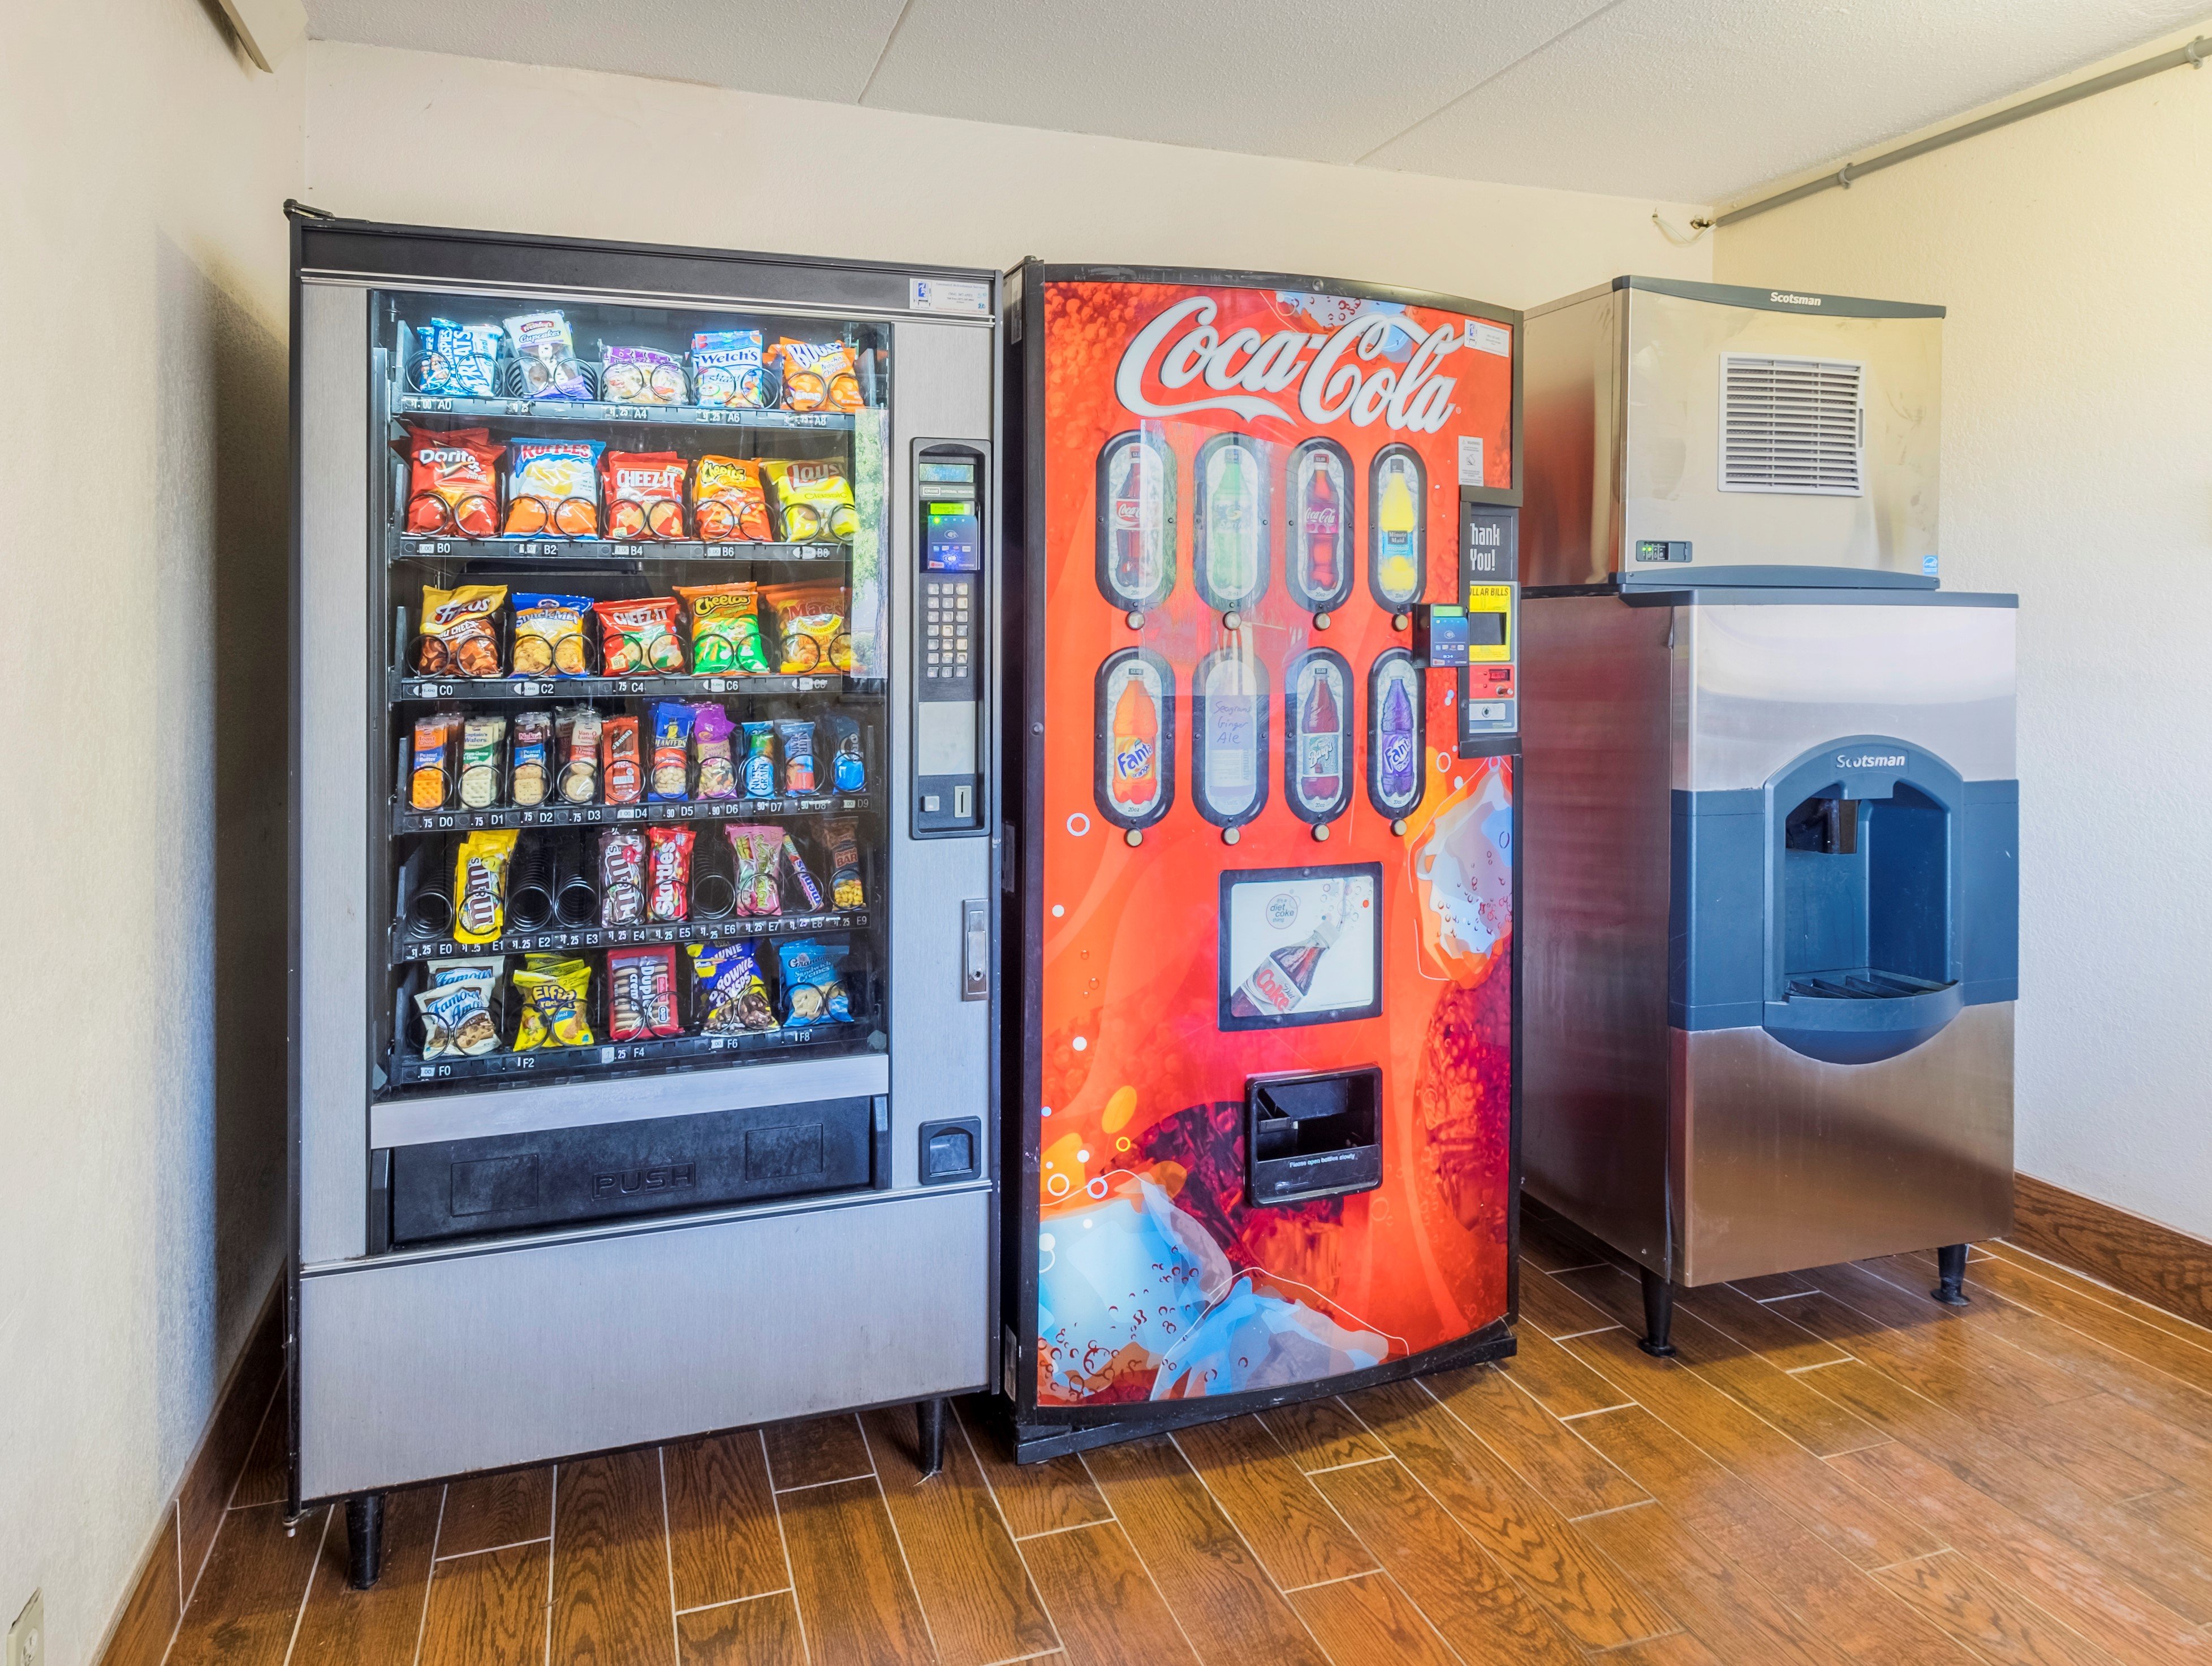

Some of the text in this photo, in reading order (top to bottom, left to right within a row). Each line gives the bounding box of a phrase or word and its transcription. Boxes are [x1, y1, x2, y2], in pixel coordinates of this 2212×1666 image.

[1770, 292, 1821, 306] Scotsman
[519, 330, 561, 343] Cupcakes
[701, 350, 758, 364] Welch's
[1115, 296, 1465, 434] Coca-Cola
[438, 400, 452, 410] A0
[635, 408, 647, 419] A4
[728, 412, 740, 423] A6
[814, 416, 826, 426] A8
[419, 449, 482, 473] Doritos
[701, 462, 745, 484] Cheetos
[437, 543, 451, 554] B0
[544, 545, 557, 555] B2
[631, 546, 643, 556] B4
[722, 547, 735, 557] B6
[1470, 549, 1496, 571] You!
[1490, 587, 1509, 597] BILLS
[695, 594, 751, 617] Cheetos
[435, 599, 490, 624] Fros
[439, 685, 453, 696] C0
[541, 684, 554, 694] C2
[631, 681, 644, 692] C4
[727, 680, 739, 691] C6
[1218, 716, 1249, 731] Ginger
[1217, 732, 1241, 744] Ale
[1116, 742, 1154, 778] Fanta
[1836, 754, 1905, 769] Scotsman
[753, 801, 783, 813] .90 D7
[797, 800, 809, 811] .90
[857, 799, 869, 808] D9
[635, 808, 648, 818] D4
[663, 806, 694, 819] .90 D5
[708, 804, 739, 815] .90 D6
[471, 814, 503, 827] .75 D1
[520, 812, 553, 824] .75 D2
[570, 810, 601, 823] .75 D3
[419, 817, 453, 828] .75 D0
[836, 853, 857, 867] BAR
[656, 841, 676, 916] Skittles
[1270, 903, 1286, 912] diet
[769, 921, 779, 931] E7
[812, 918, 823, 928] E8
[857, 916, 867, 926] E9
[633, 930, 645, 941] E4
[679, 927, 691, 938] E5
[725, 925, 736, 935] E6
[538, 937, 551, 947] E2
[587, 934, 598, 944] E3
[439, 944, 452, 955] E0
[493, 940, 503, 951] E1
[435, 969, 492, 987] Famous
[1256, 969, 1290, 1012] Coke
[427, 990, 480, 1018] Famous
[800, 1031, 810, 1042] F8
[727, 1039, 738, 1050] F6
[634, 1047, 645, 1058] F4
[523, 1058, 534, 1068] F2
[439, 1065, 451, 1076] F0
[595, 1164, 692, 1198] PUSH
